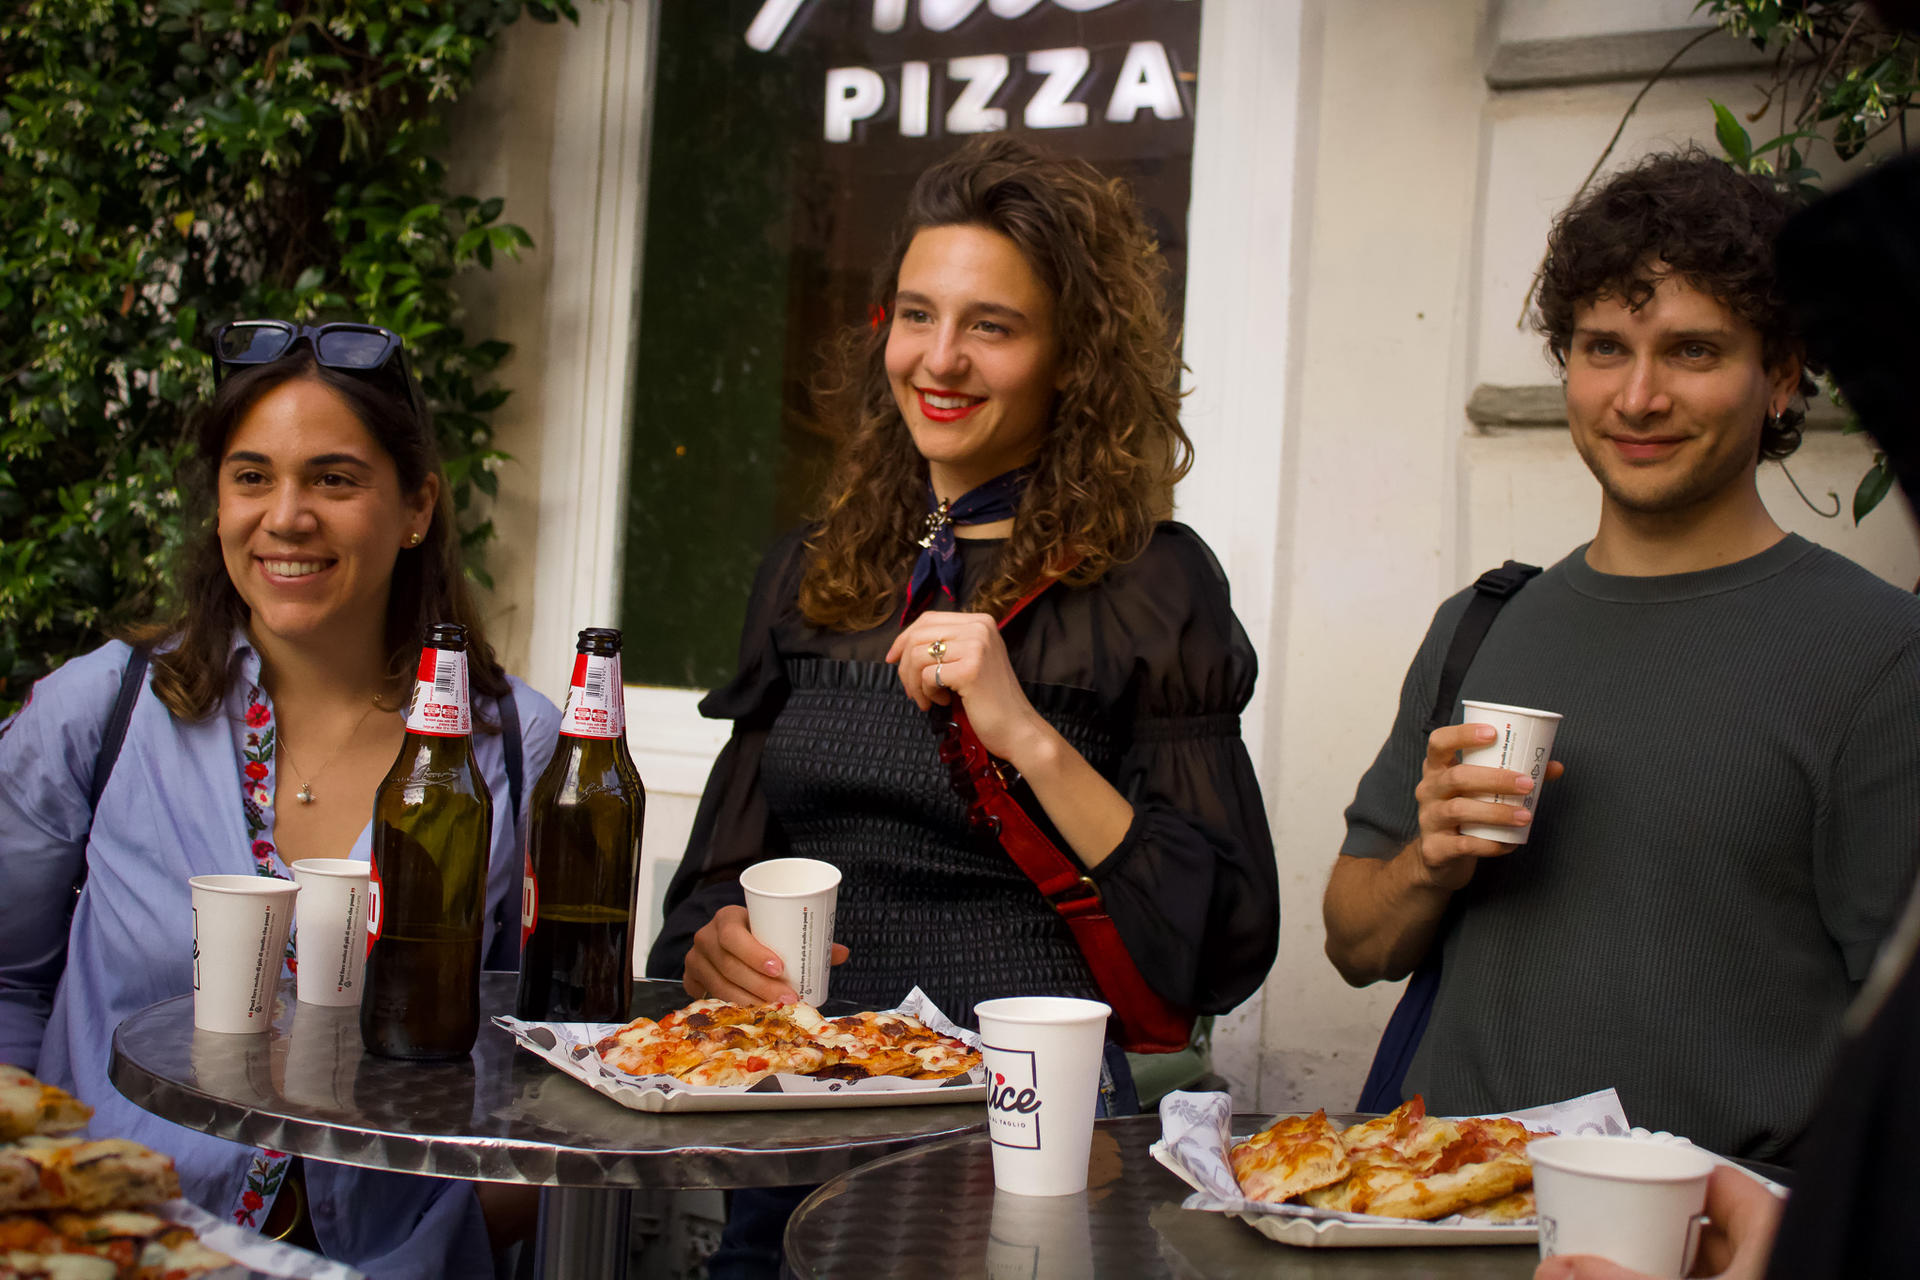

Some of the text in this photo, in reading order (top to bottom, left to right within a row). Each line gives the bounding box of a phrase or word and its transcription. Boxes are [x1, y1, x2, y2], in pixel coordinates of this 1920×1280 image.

[824, 40, 1184, 143] PIZZA
[985, 1066, 1042, 1114] lice
[1000, 1119, 1026, 1128] TAGLIO
